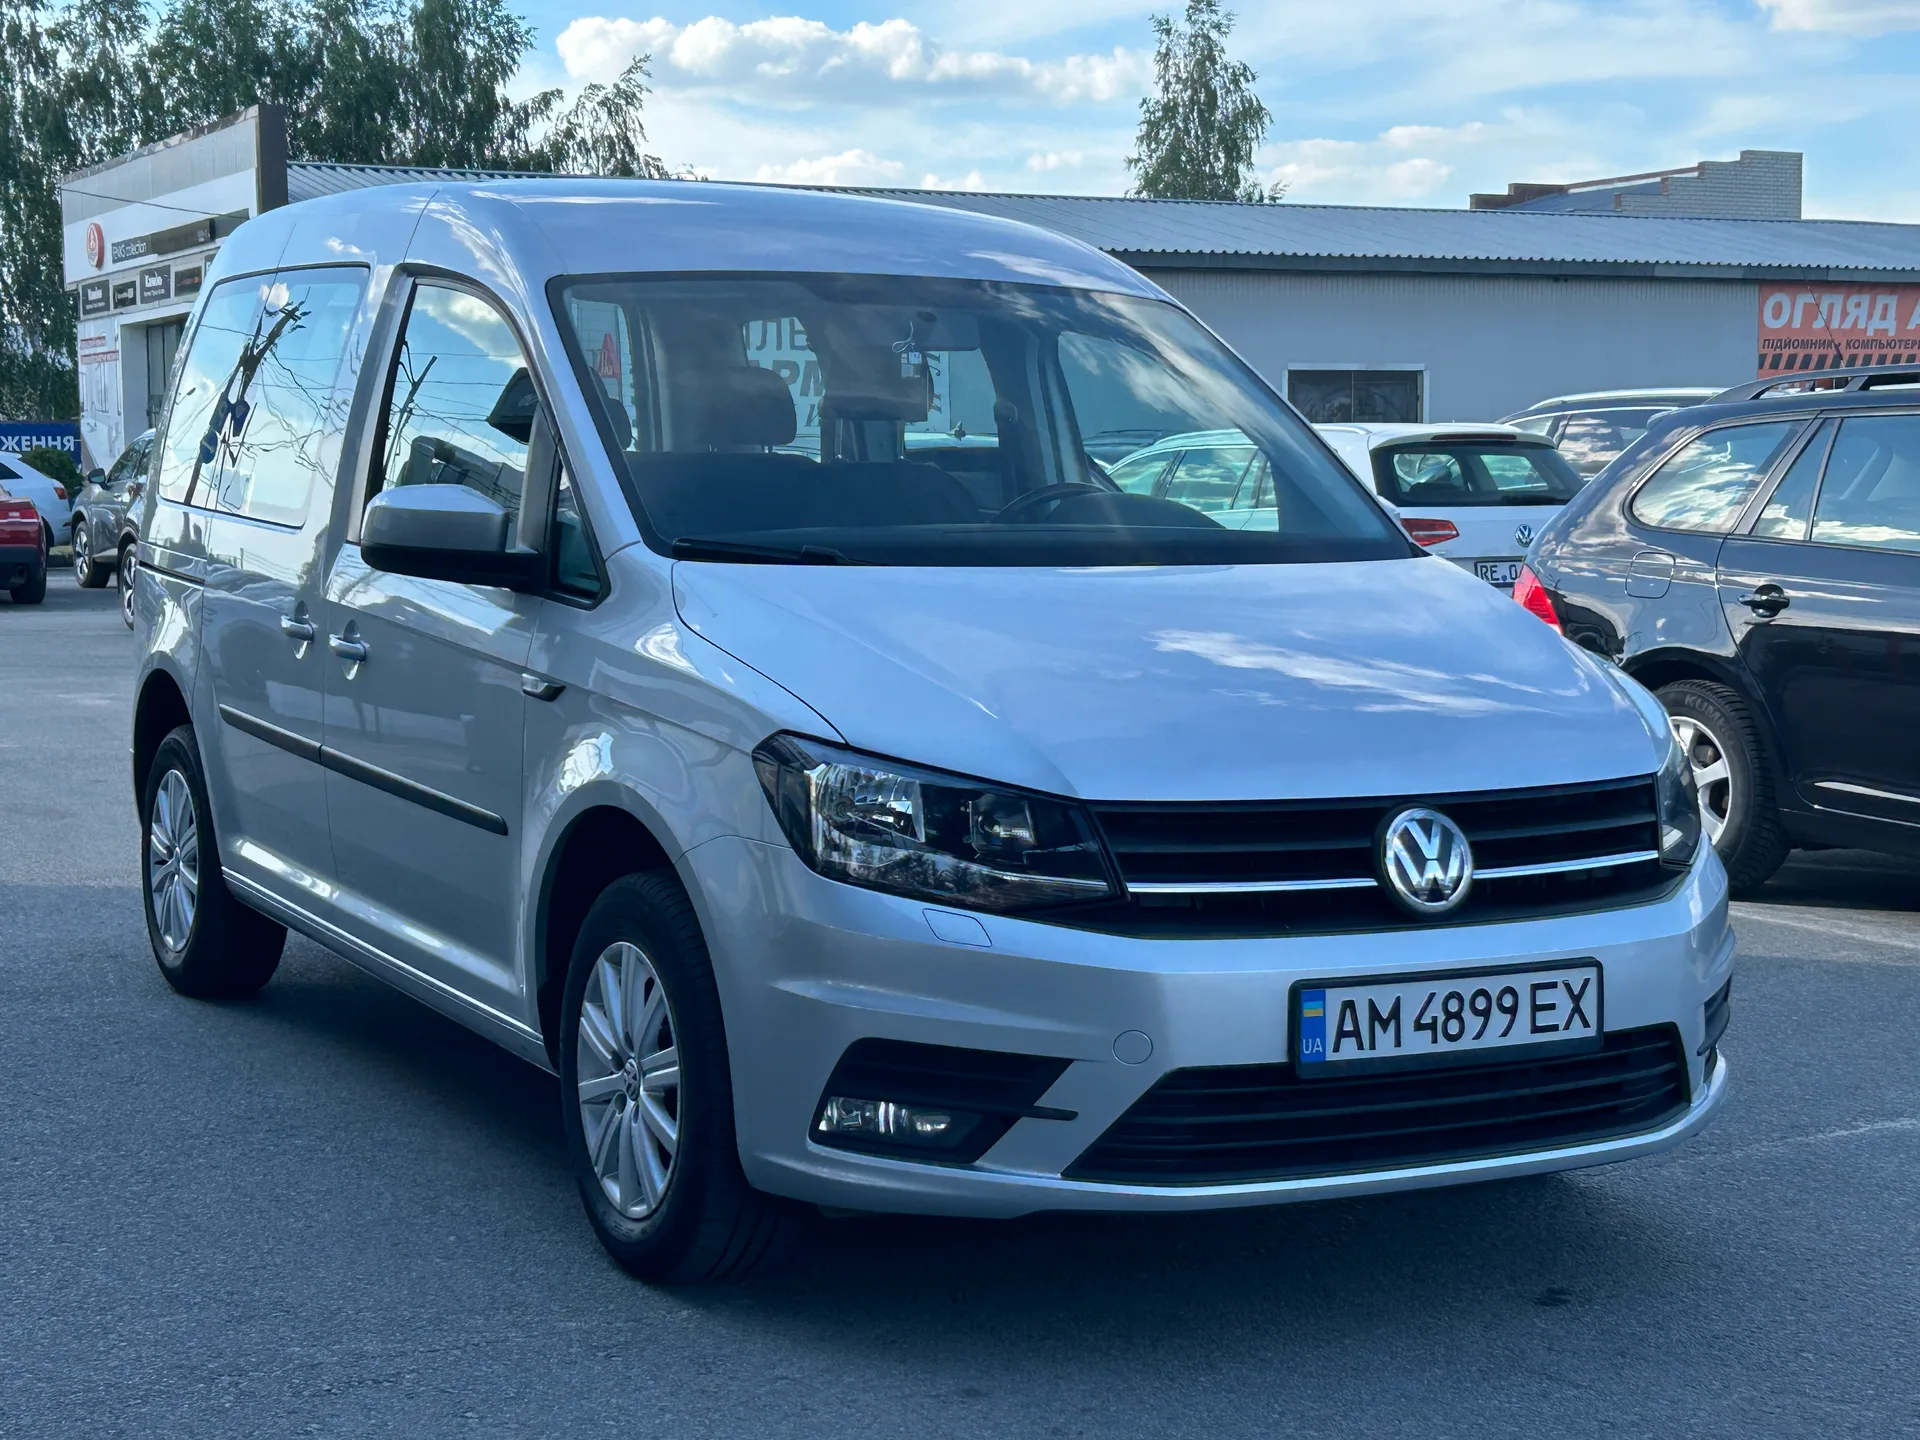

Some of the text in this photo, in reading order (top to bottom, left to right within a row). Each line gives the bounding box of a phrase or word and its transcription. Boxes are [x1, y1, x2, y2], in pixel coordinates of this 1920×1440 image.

[1763, 292, 1898, 337] ОГЛЯД
[1845, 338, 1920, 350] КОМПЬЮТЕР
[0, 435, 75, 451] ЖЕННЯ
[1480, 564, 1500, 581] RE
[1302, 977, 1592, 1054] UA AM 4899 EX
